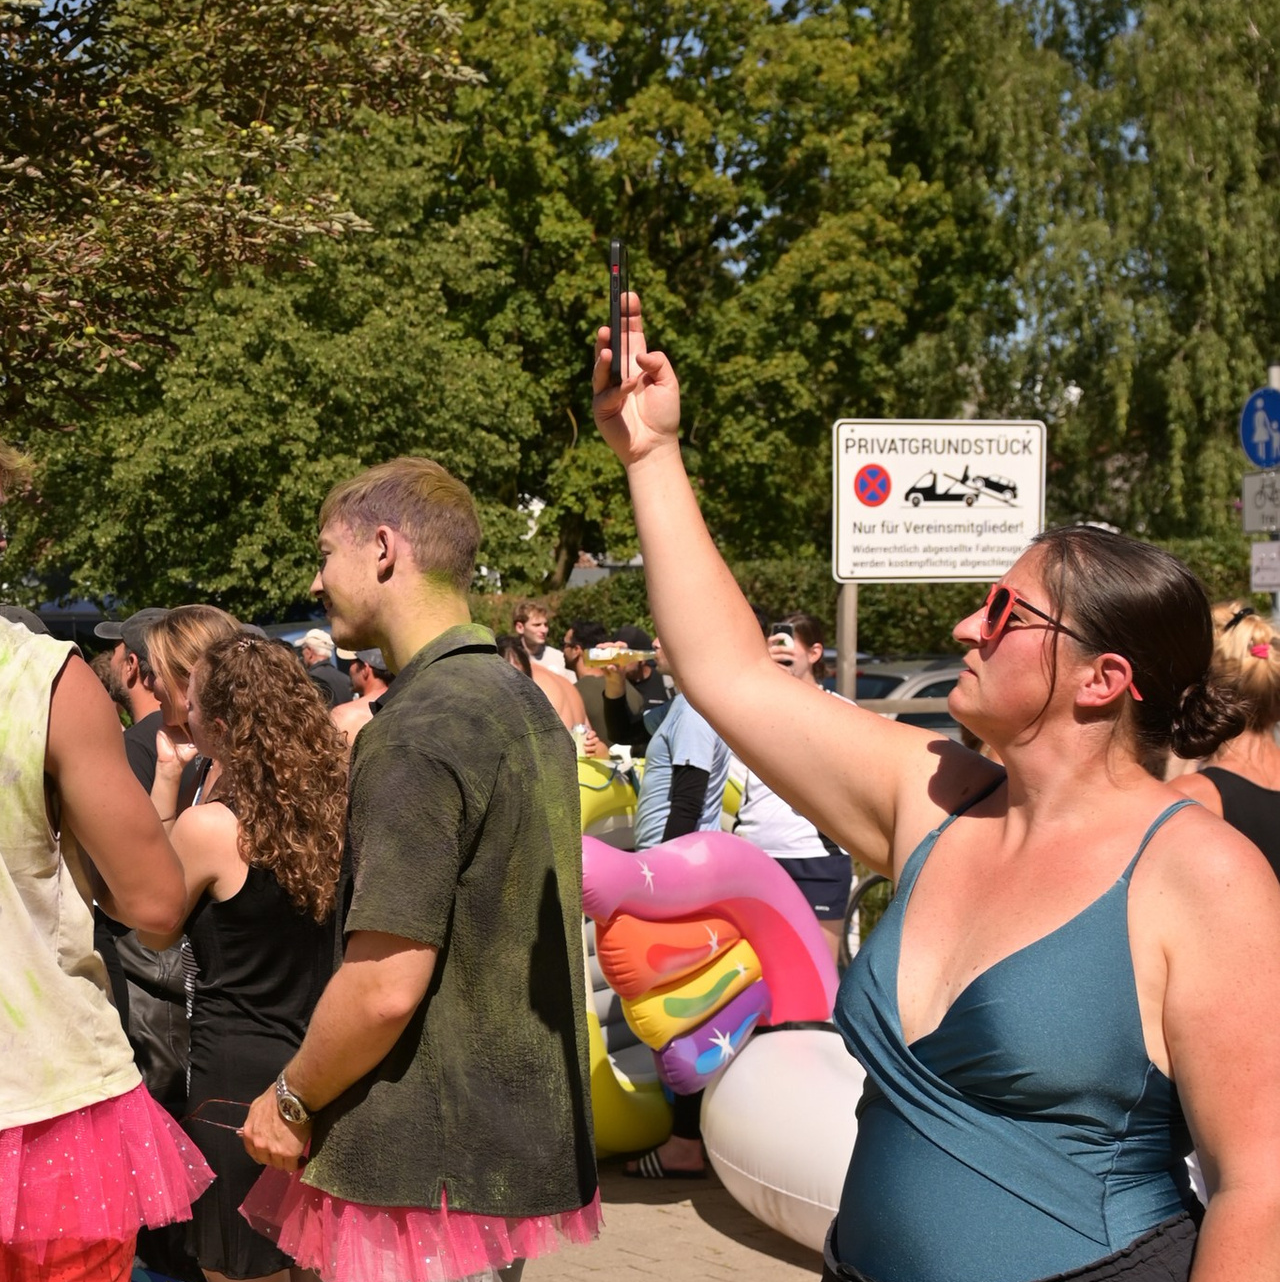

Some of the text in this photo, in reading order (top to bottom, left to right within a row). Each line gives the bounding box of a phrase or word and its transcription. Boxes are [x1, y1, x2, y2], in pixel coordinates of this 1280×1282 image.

[845, 435, 1033, 455] PRIVATGRUNDSTÜCK
[853, 520, 1024, 537] Nur für Vereinsmitglieder!
[852, 544, 920, 554] Widerrechtlich
[923, 544, 972, 555] abgestellte
[852, 559, 886, 568] werden
[889, 558, 958, 569] kostenpflichtig
